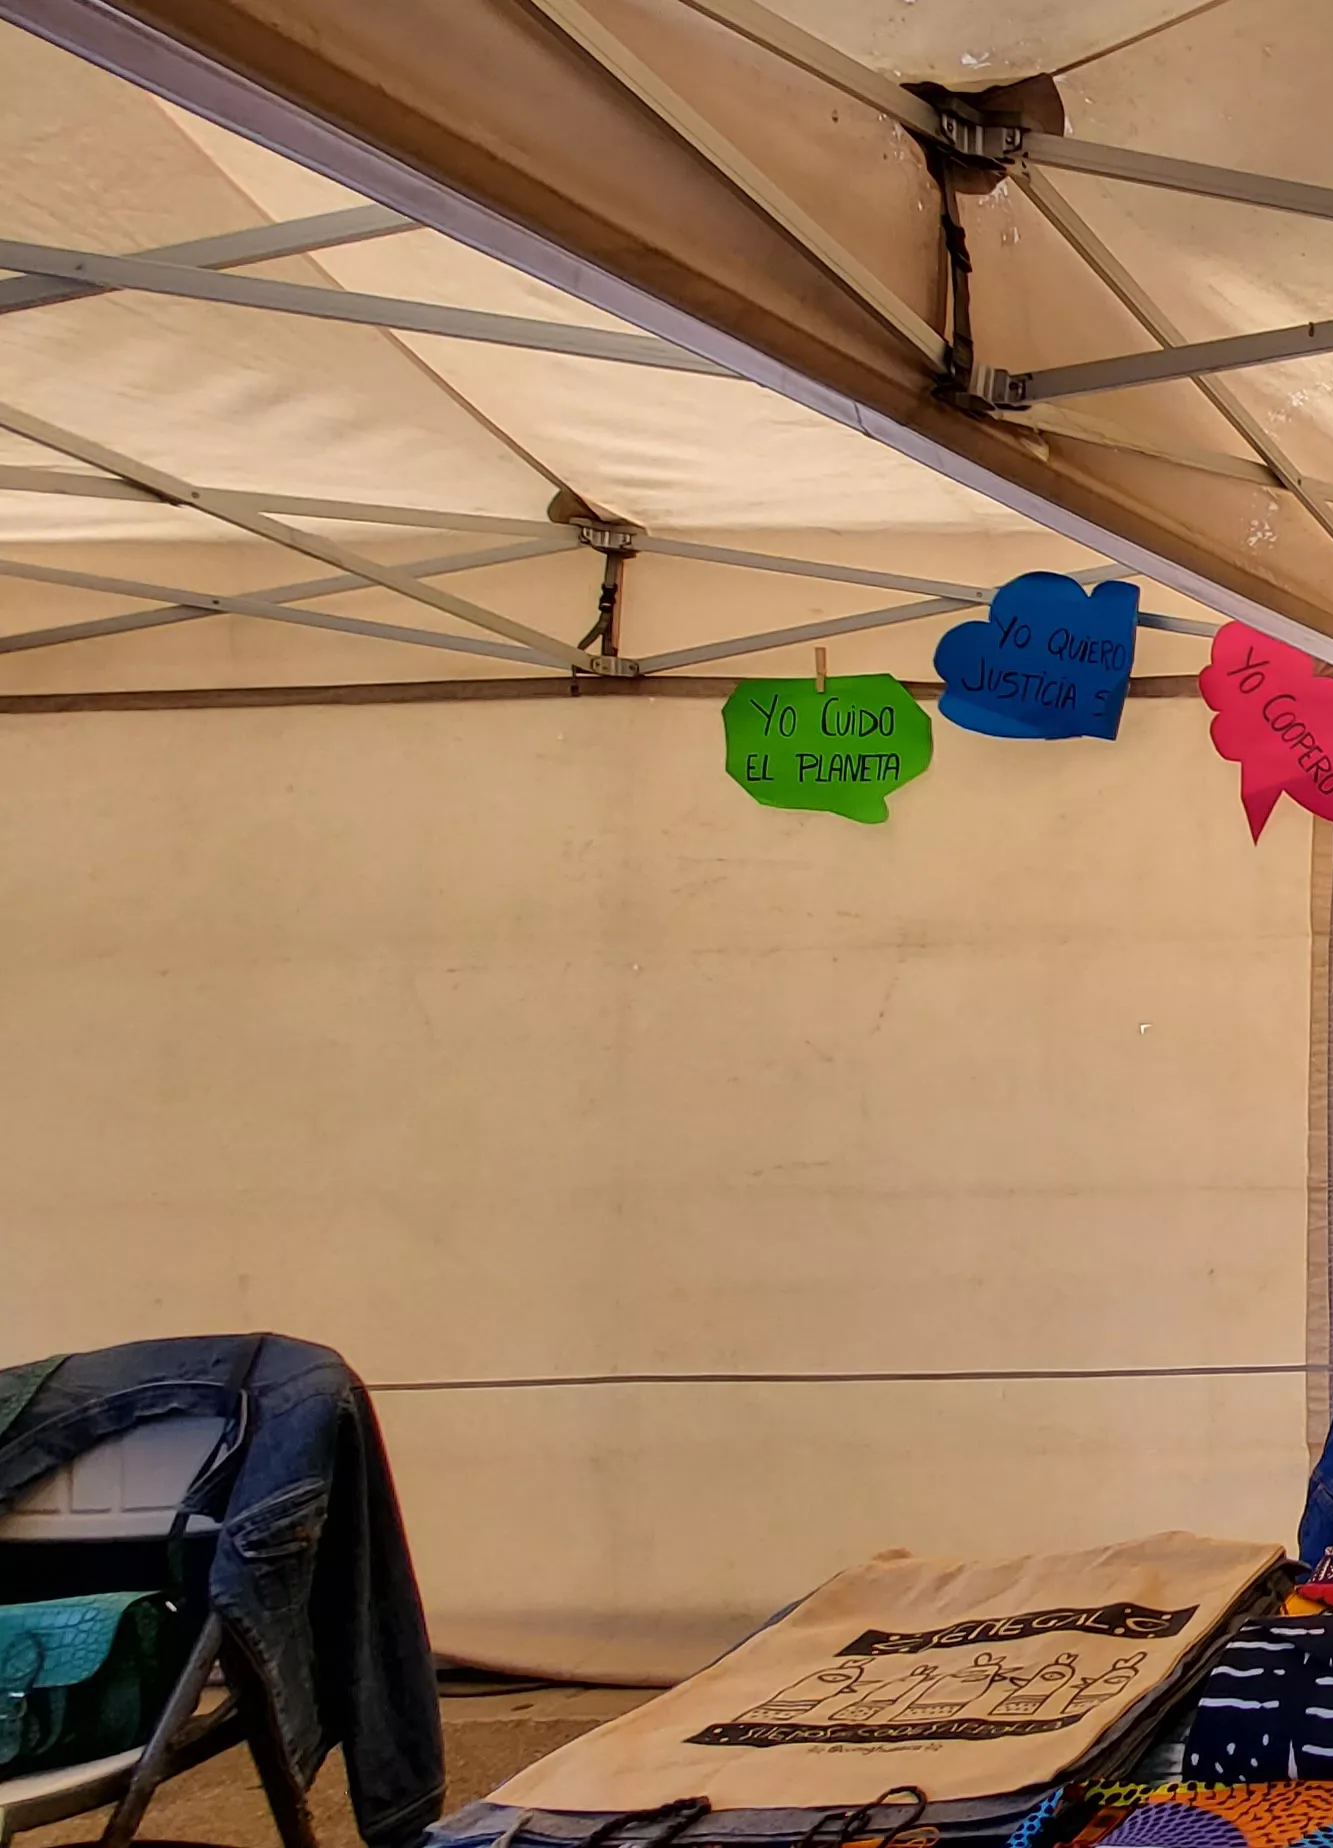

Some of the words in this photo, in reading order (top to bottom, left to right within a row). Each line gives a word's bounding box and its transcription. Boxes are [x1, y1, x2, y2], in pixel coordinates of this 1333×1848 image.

[994, 613, 1032, 652] YO
[1227, 645, 1264, 695] YO
[750, 695, 797, 739] YO
[746, 752, 775, 783] EL
[796, 751, 902, 784] PLANETA
[916, 1609, 1113, 1654] SENEGAL
